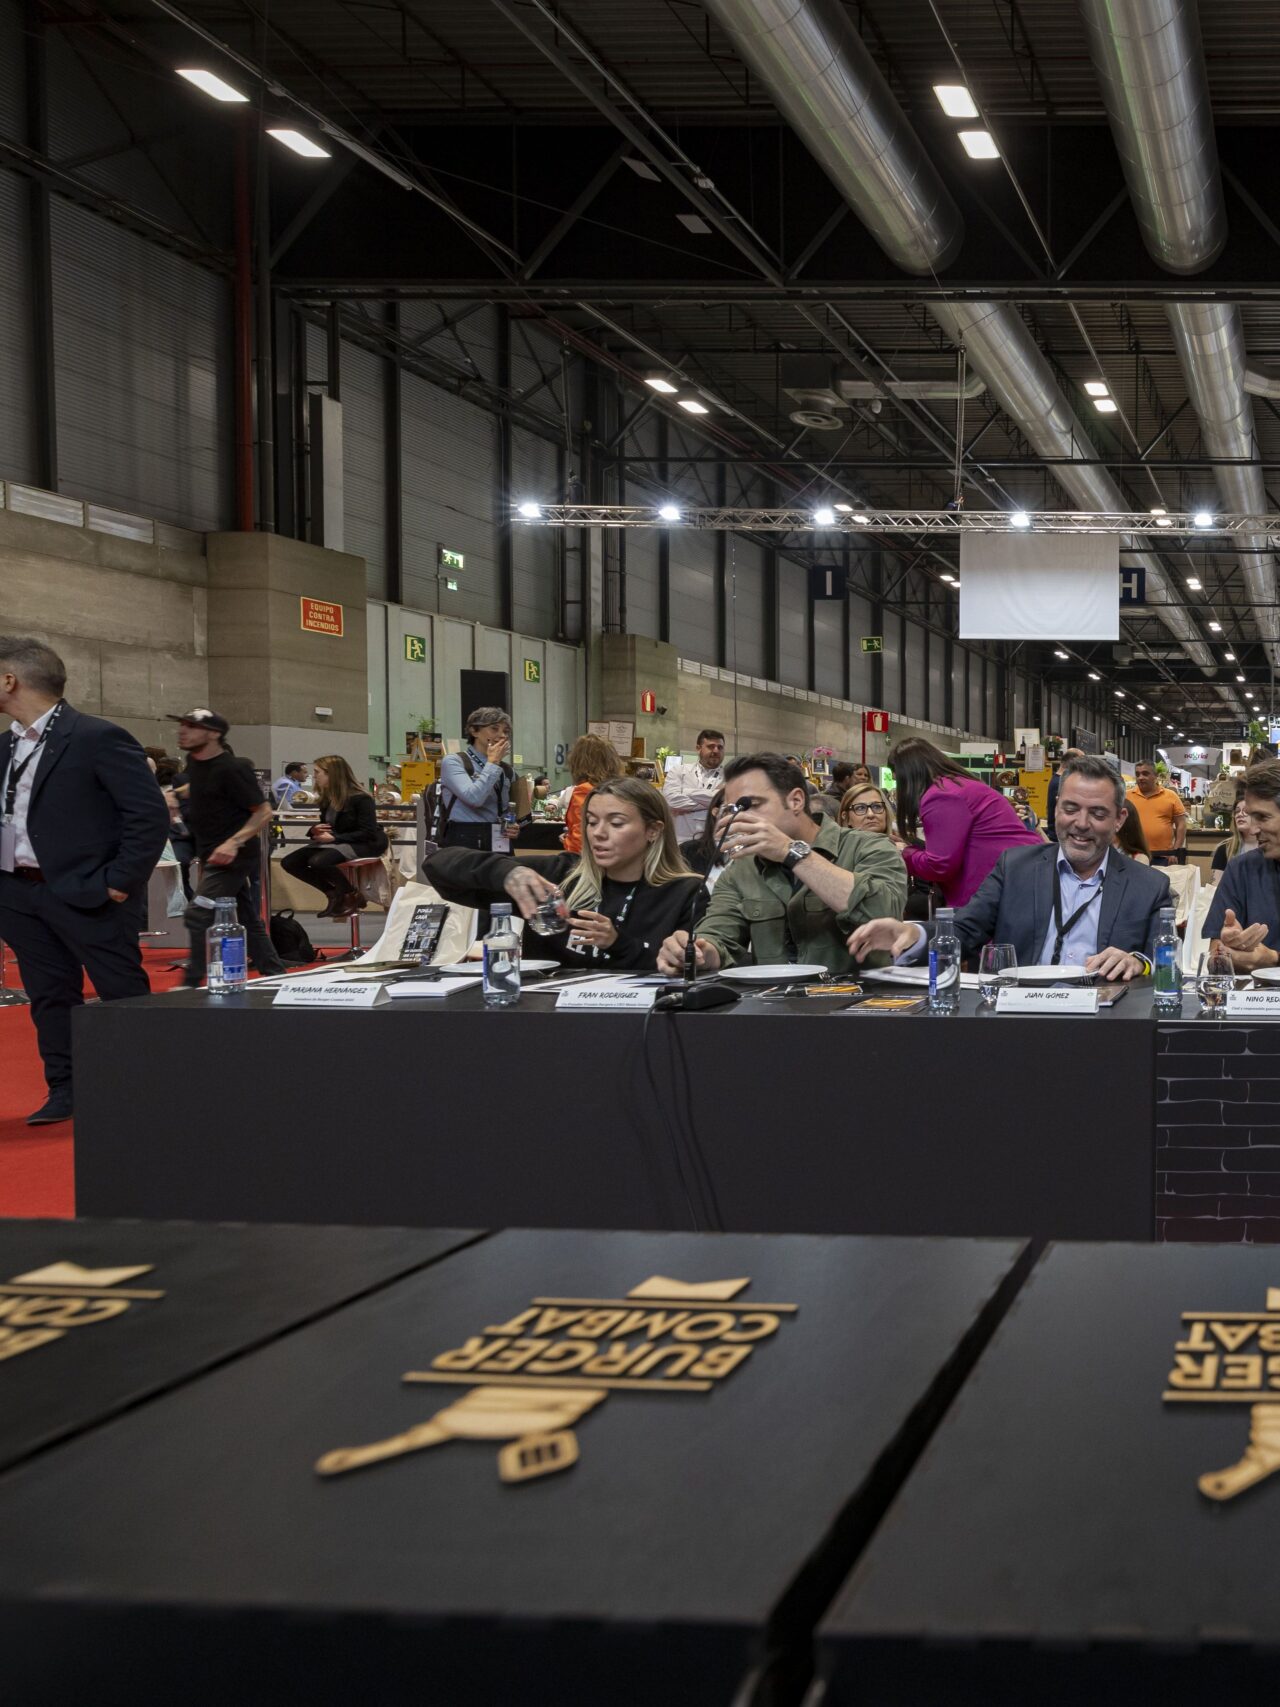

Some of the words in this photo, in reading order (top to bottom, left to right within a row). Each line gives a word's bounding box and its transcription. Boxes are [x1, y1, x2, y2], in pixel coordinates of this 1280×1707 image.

[825, 570, 832, 595] I
[1119, 573, 1137, 598] H
[309, 611, 335, 622] CONTRA
[310, 603, 334, 613] EQUIPO
[306, 620, 339, 631] INCENDIOS
[483, 1306, 781, 1341] COMBAT
[430, 1336, 755, 1379] BURGER
